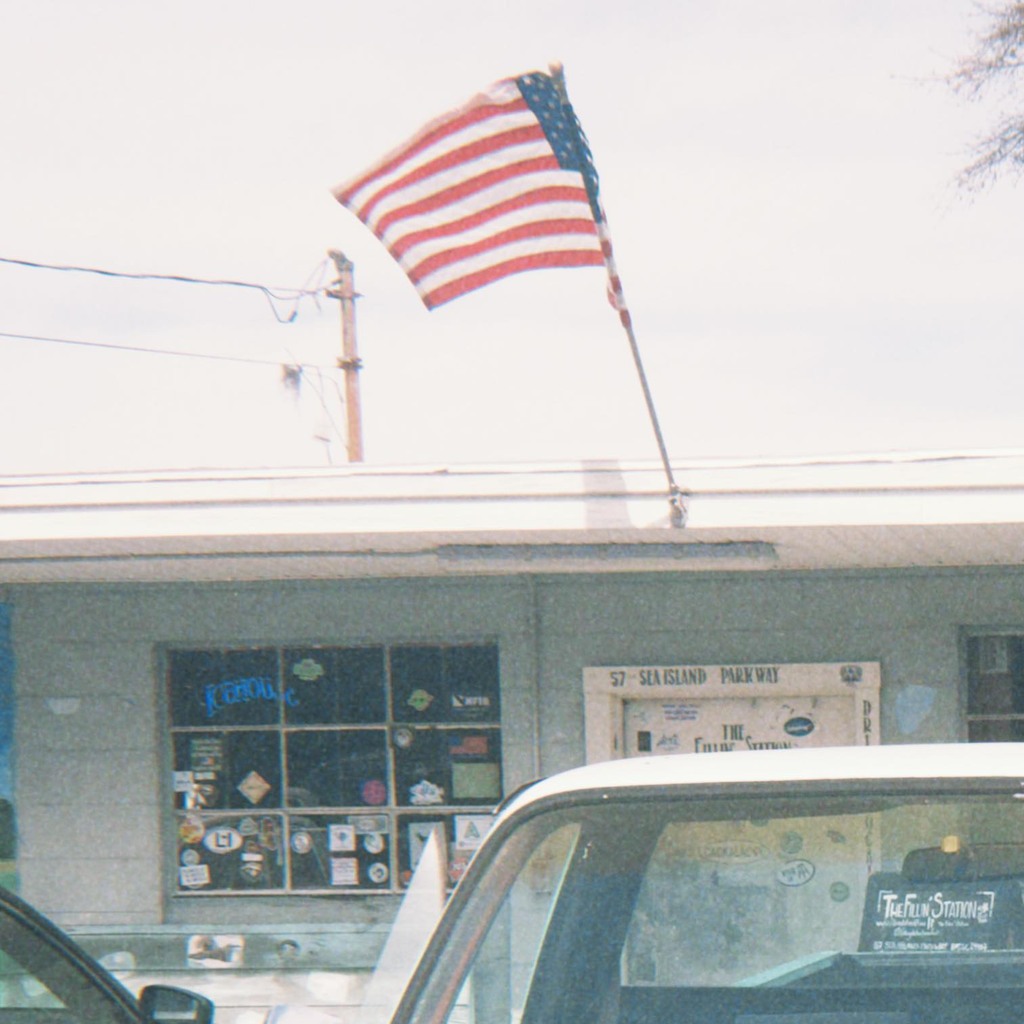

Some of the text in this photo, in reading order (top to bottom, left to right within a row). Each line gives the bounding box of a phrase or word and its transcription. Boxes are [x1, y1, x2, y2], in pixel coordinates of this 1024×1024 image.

[610, 671, 627, 687] 57
[639, 669, 661, 686] SEA
[662, 668, 708, 686] ISLAND
[721, 723, 744, 741] THE
[883, 894, 904, 919] THE
[931, 892, 977, 919] STATION
